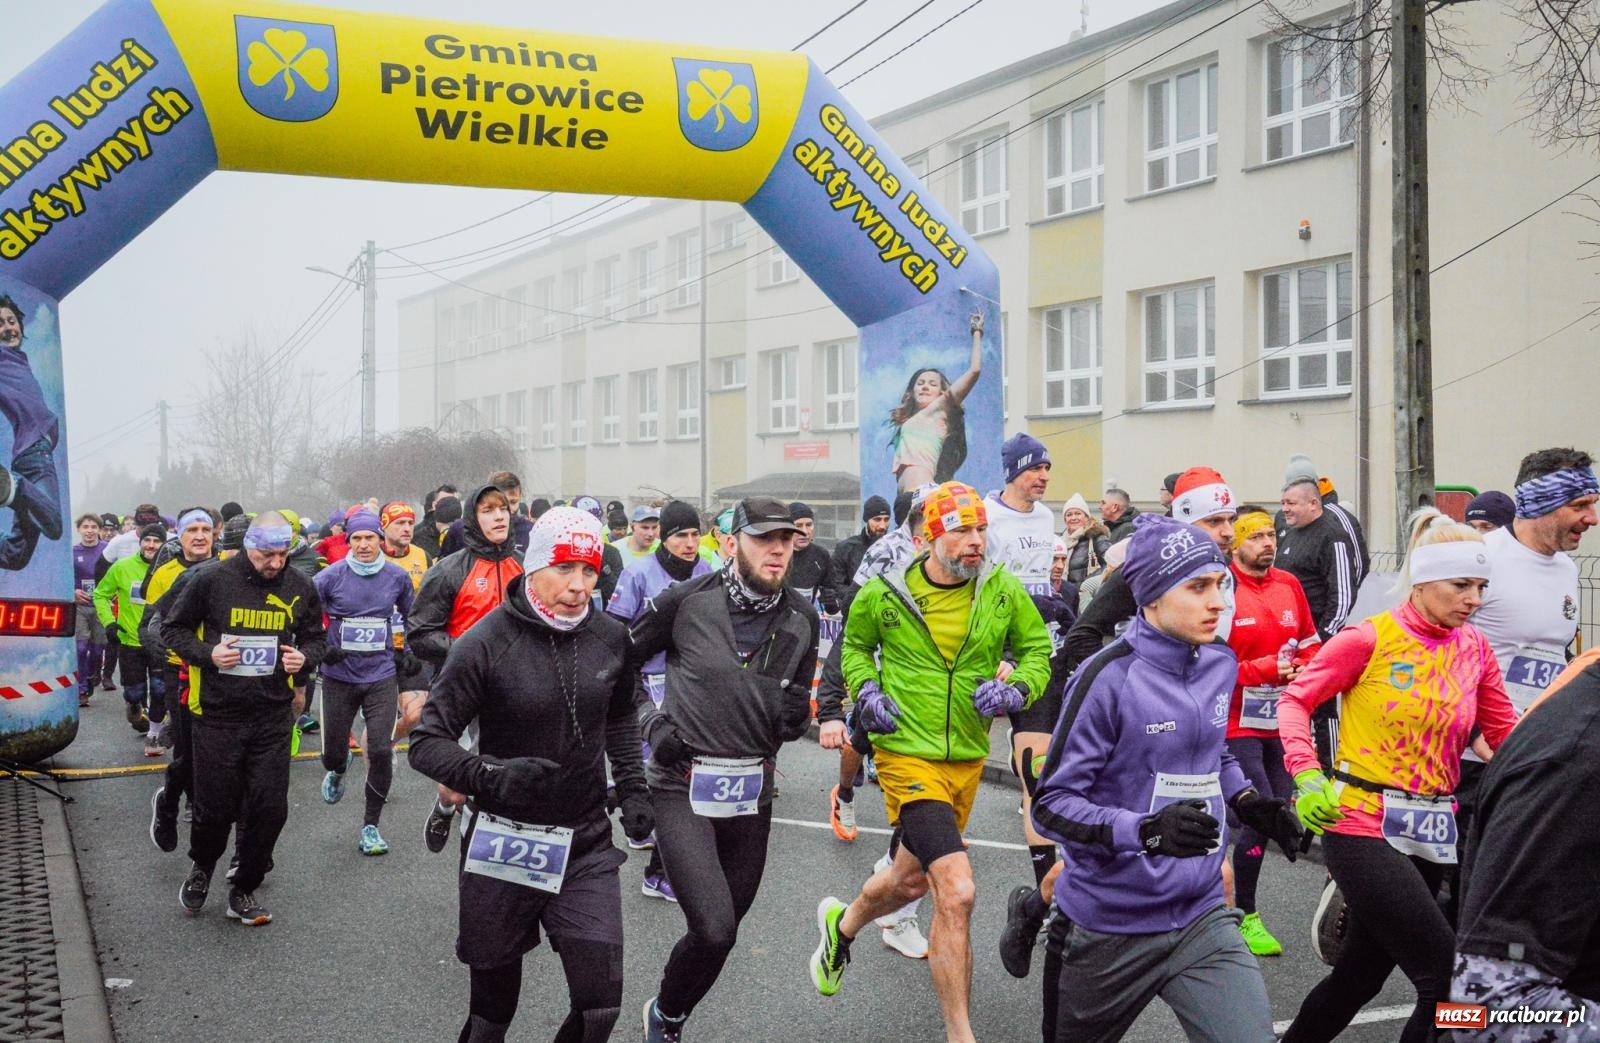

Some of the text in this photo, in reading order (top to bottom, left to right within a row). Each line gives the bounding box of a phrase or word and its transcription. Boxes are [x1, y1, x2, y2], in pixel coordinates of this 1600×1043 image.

[424, 34, 597, 72] Gmina
[50, 39, 156, 127] ludzi
[380, 62, 644, 113] Pietrowice
[415, 107, 609, 150] Wielkie
[0, 88, 191, 259] aktywnych
[820, 105, 966, 267] Gmina ludzi
[795, 140, 937, 292] aktywnych
[230, 608, 286, 630] PUMA
[354, 628, 375, 642] 29
[237, 648, 267, 665] 02
[1258, 701, 1278, 718] 4
[713, 777, 744, 800] 34
[1399, 811, 1448, 842] 148
[488, 837, 550, 870] 125
